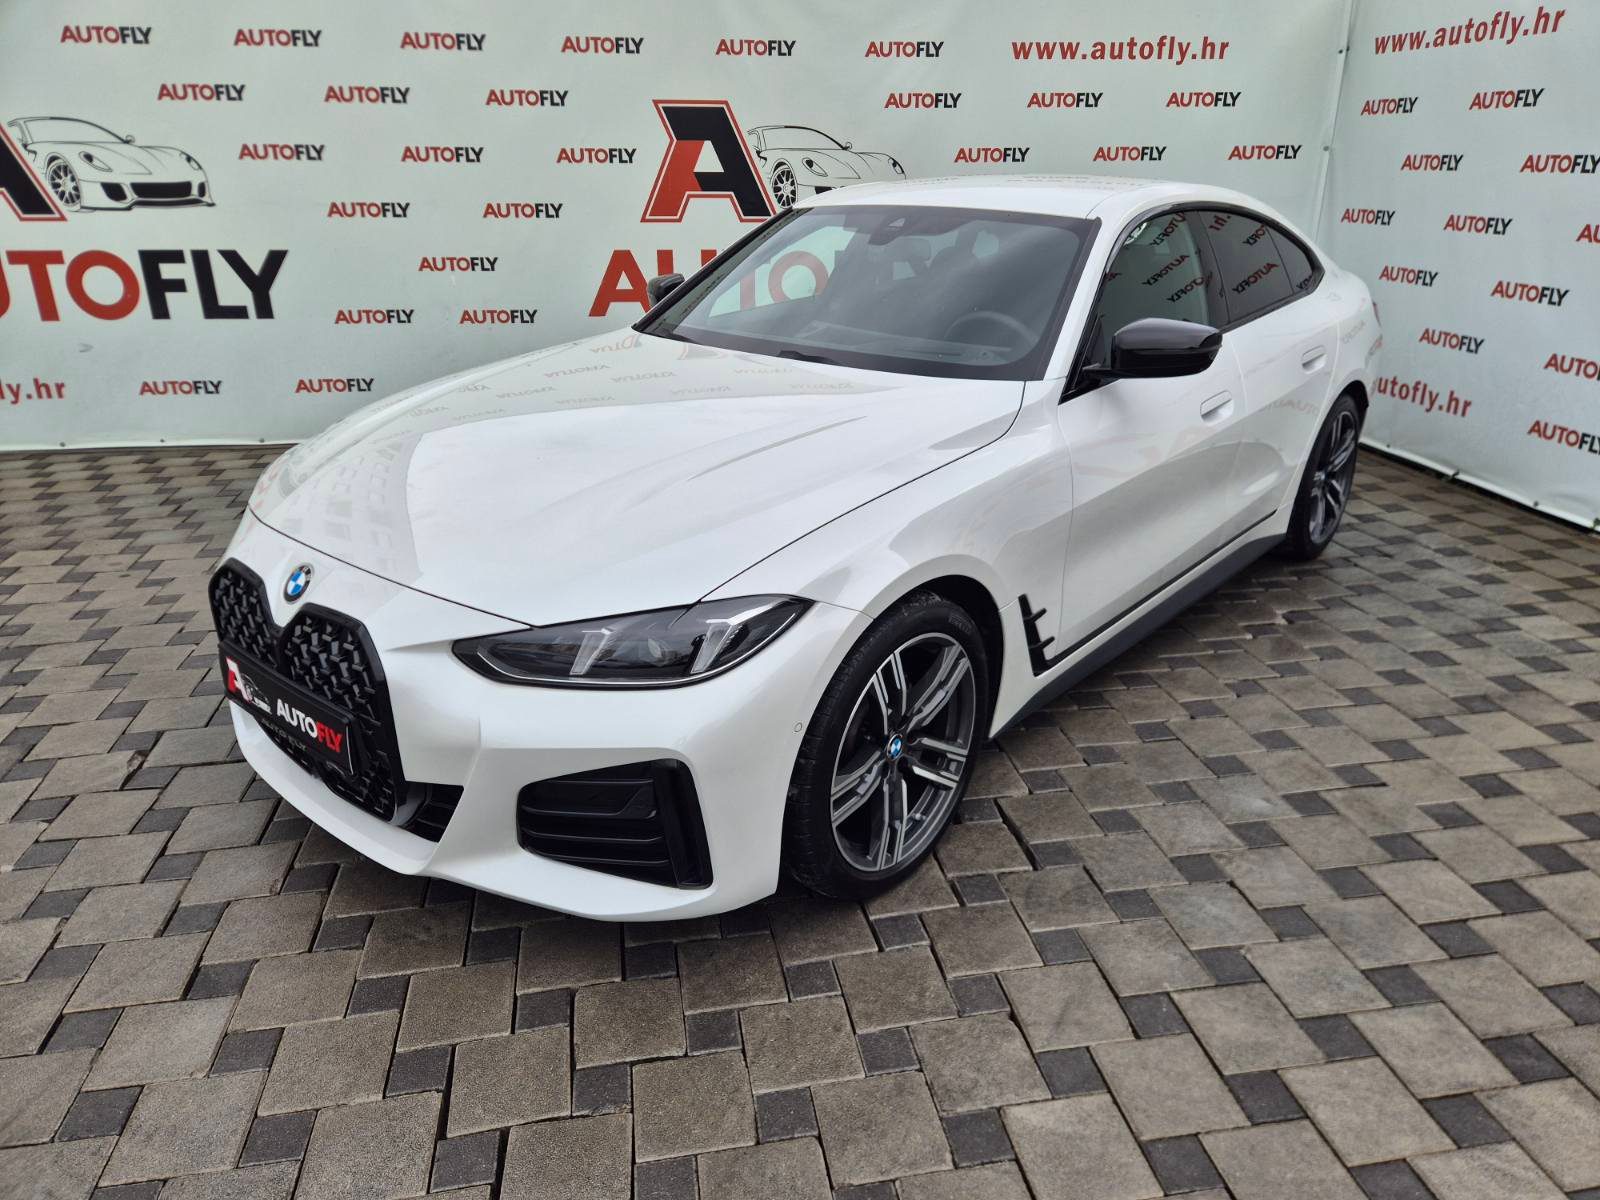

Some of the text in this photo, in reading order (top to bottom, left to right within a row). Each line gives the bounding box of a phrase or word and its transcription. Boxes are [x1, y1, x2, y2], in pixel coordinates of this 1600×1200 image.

[61, 25, 152, 44] AUTOFLY
[234, 29, 322, 47] AUTOFLY
[1375, 6, 1566, 54] www.autofly.hr
[400, 32, 486, 51] AUTOFLY
[561, 36, 644, 54] AUTOFLY
[716, 39, 796, 56] AUTOFLY
[865, 41, 944, 57] AUTOFLY
[1012, 35, 1229, 65] www.autofly.hr
[158, 84, 246, 101] AUTOFLY
[324, 86, 410, 104] AUTOFLY
[486, 89, 568, 107] AUTOFLY
[884, 93, 962, 109] AUTOFLY
[1027, 92, 1103, 108] AUTOFLY
[1166, 92, 1241, 107] AUTOFLY
[1469, 88, 1545, 110] AUTOFLY
[1361, 97, 1418, 115] AUTOFLY
[239, 144, 325, 161] AUTOFLY
[401, 146, 484, 163] AUTOFLY
[557, 148, 637, 164] AUTOFLY
[954, 147, 1030, 163] AUTOFLY
[1093, 146, 1167, 161] AUTOFLY
[1228, 145, 1302, 160] AUTOFLY
[1401, 154, 1464, 171] AUTOFLY
[1520, 154, 1600, 174] AUTOFLY
[328, 202, 410, 218] AUTOFLY
[483, 203, 563, 219] AUTOFLY
[1341, 209, 1395, 226] AUTOFLY
[1444, 215, 1513, 235] AUTOFLY
[418, 257, 498, 272] AUTOFLY
[1379, 266, 1438, 287] AUTOFLY
[0, 250, 289, 321] TOFLY
[1491, 281, 1570, 307] AUTOFLY
[335, 309, 414, 324] AUTOFLY
[460, 309, 537, 324] AUTOFLY
[1419, 328, 1484, 354] AUTOFLY
[1544, 354, 1600, 381] AUTO
[140, 380, 222, 395] AUTOFLY
[295, 378, 374, 393] AUTOFLY
[1528, 420, 1600, 455] AUTOFL
[276, 699, 343, 753] AUTOFLY
